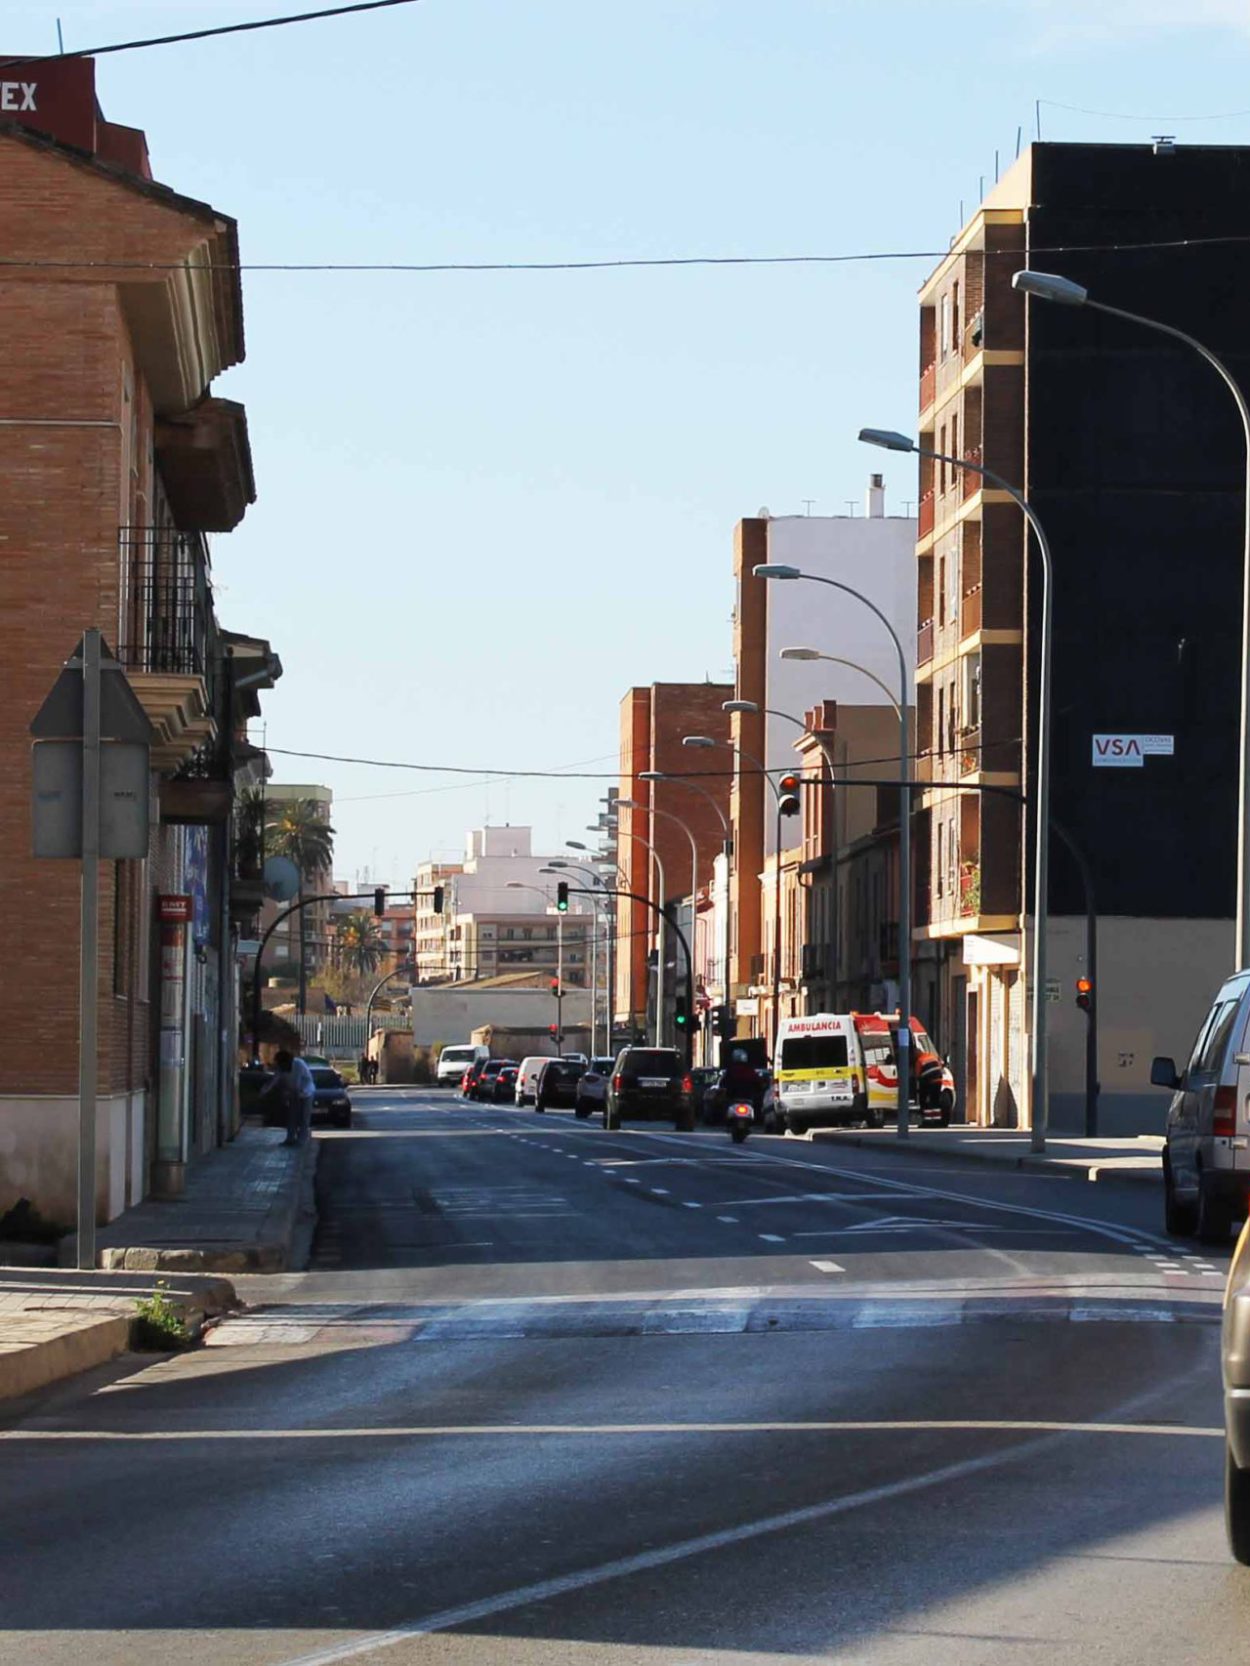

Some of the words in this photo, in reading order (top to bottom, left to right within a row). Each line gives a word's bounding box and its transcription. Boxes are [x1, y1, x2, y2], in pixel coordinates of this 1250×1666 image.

[0, 82, 37, 111] EX
[1095, 739, 1141, 756] VSA
[788, 1021, 841, 1032] AMBULANCIA
